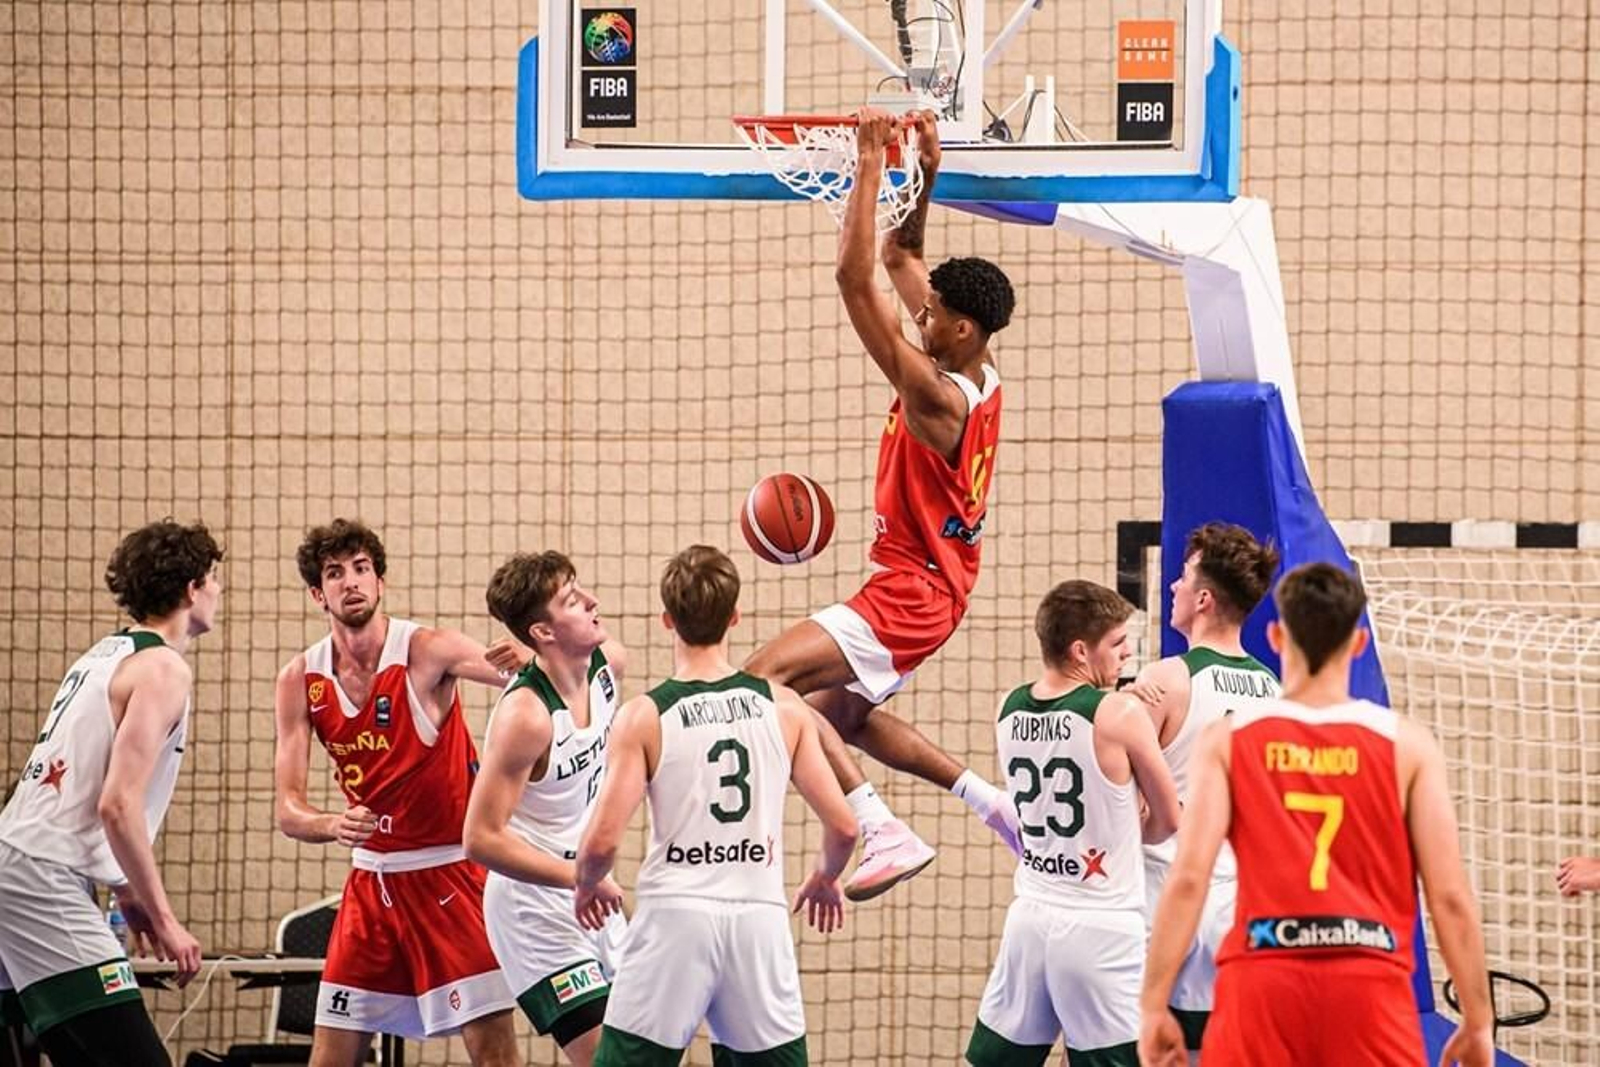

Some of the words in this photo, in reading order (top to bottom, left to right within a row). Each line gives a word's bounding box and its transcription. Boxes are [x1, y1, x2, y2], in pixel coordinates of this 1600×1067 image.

[589, 77, 628, 97] FIBA
[1125, 102, 1164, 122] FIBA
[1011, 715, 1072, 742] RUBINAS
[1266, 741, 1359, 776] FERRANDO
[706, 738, 751, 823] 3
[1008, 757, 1085, 838] 23
[666, 838, 766, 865] betsafe
[1284, 791, 1344, 890] 7
[1274, 918, 1394, 950] CaixaBank
